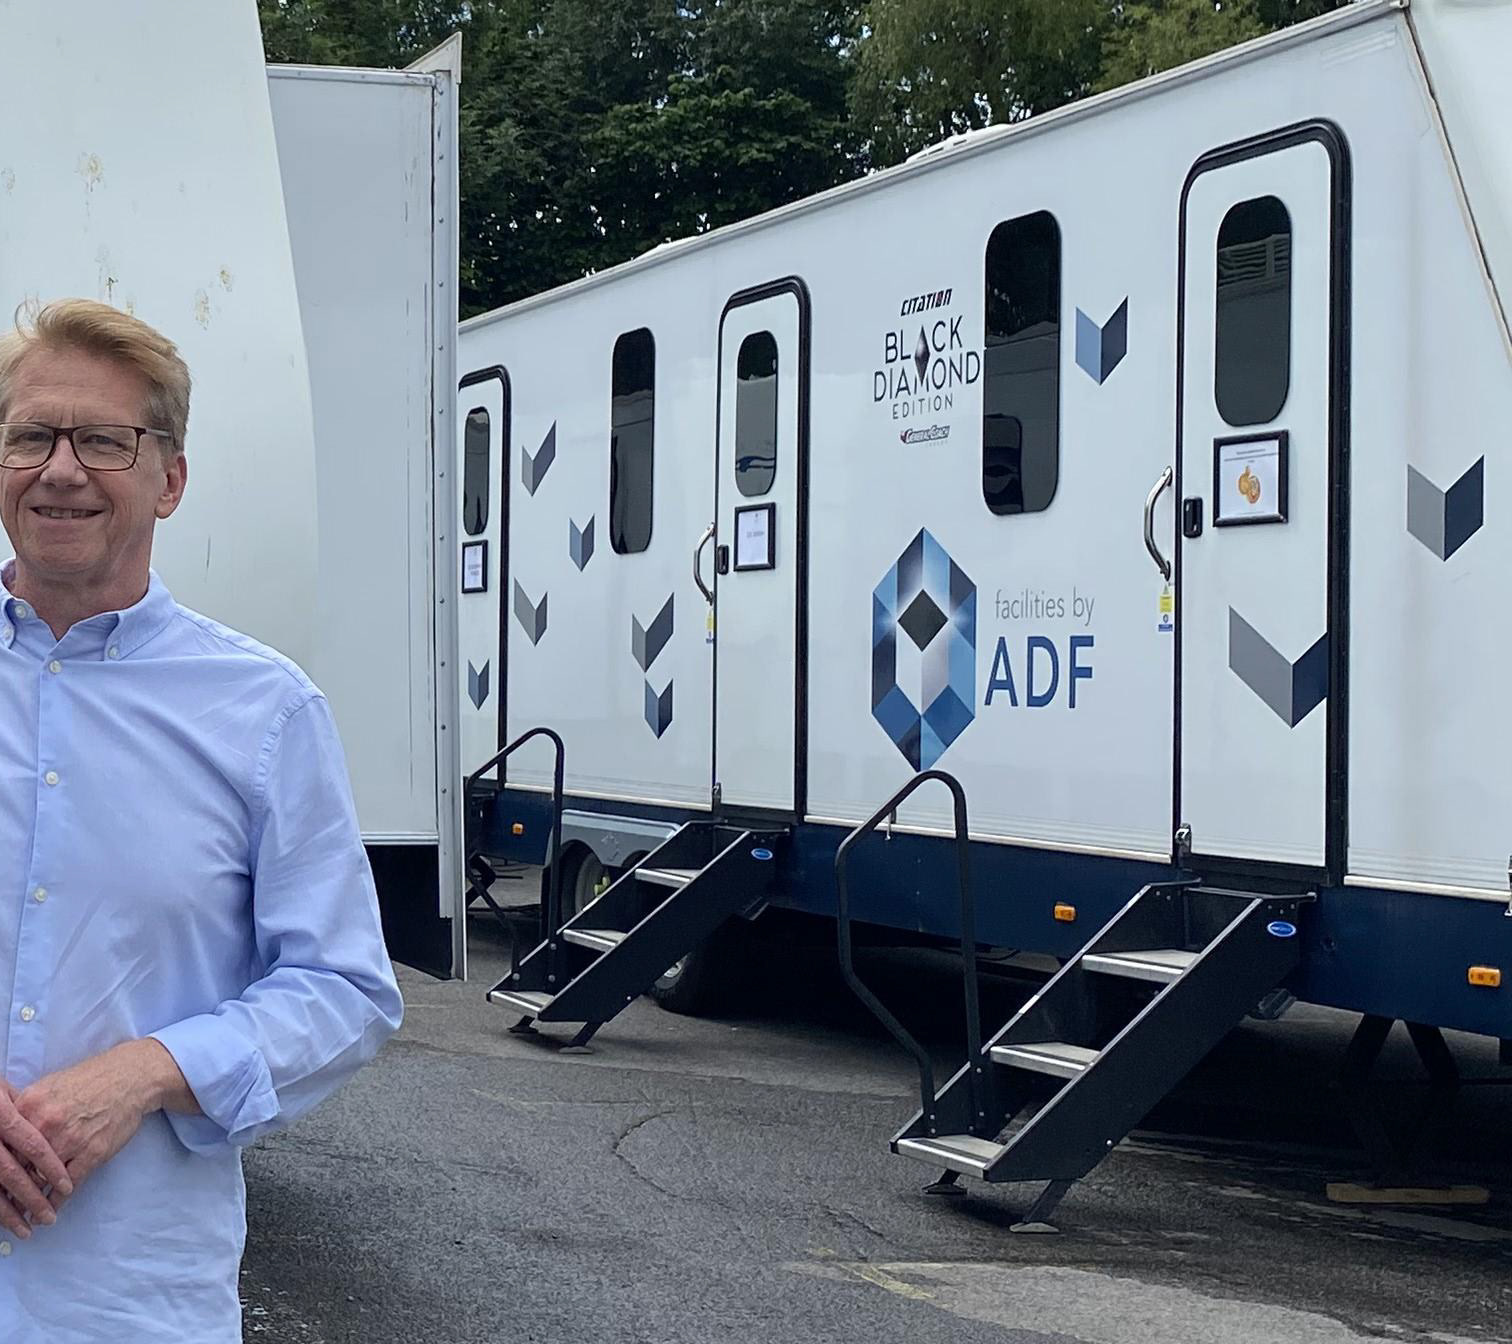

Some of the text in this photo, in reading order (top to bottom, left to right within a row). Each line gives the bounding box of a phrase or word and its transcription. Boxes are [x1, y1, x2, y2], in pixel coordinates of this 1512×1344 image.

[873, 350, 981, 403] DIAMOND
[892, 392, 954, 420] EDITION
[994, 586, 1096, 626] facilities by
[984, 634, 1095, 710] ADF
